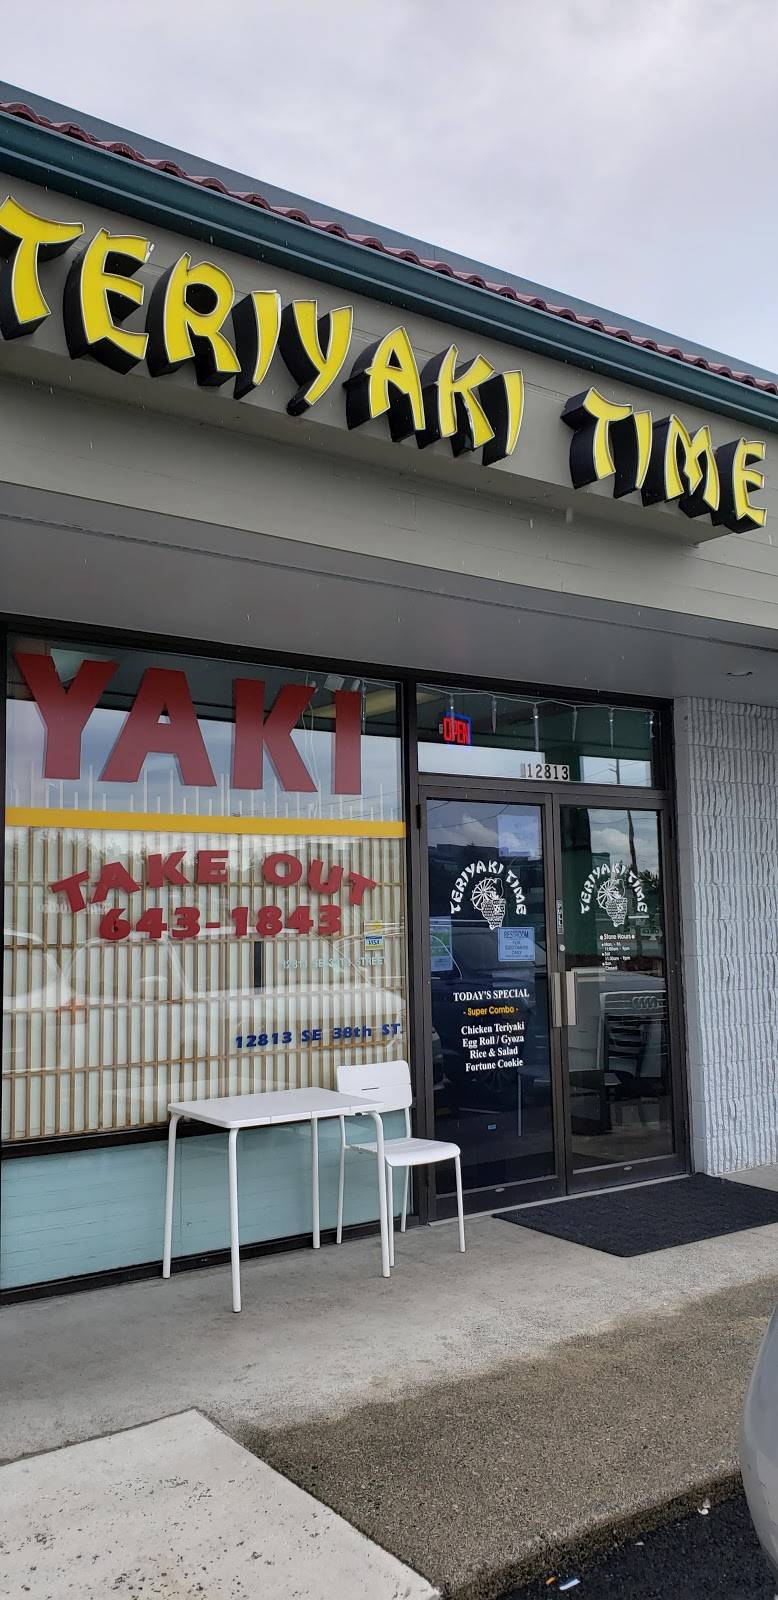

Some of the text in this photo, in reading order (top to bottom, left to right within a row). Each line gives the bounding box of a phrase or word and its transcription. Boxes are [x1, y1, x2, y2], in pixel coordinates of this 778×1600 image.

[0, 195, 768, 530] TERIYAKI TIME
[15, 653, 362, 795] YAKI
[443, 717, 470, 745] OPEN
[527, 764, 569, 780] 12813
[51, 850, 377, 913] TAKE OUT
[449, 860, 527, 915] TERIYAKI TIME
[580, 863, 648, 914] TERIYAKI TIME
[98, 904, 342, 940] 643-1843
[453, 989, 530, 1002] TODAY'S SPECIAL
[467, 1007, 487, 1017] Super
[488, 1005, 515, 1014] Combo
[235, 1023, 404, 1048] 12813 SE 38th ST.
[461, 1022, 525, 1035] Chicken Teriyaki
[462, 1038, 478, 1049] Egg
[479, 1036, 495, 1046] Roll
[501, 1034, 524, 1045] Gyoza
[469, 1046, 519, 1060] Rice & Salad
[465, 1058, 524, 1072] Fortune Cookie
